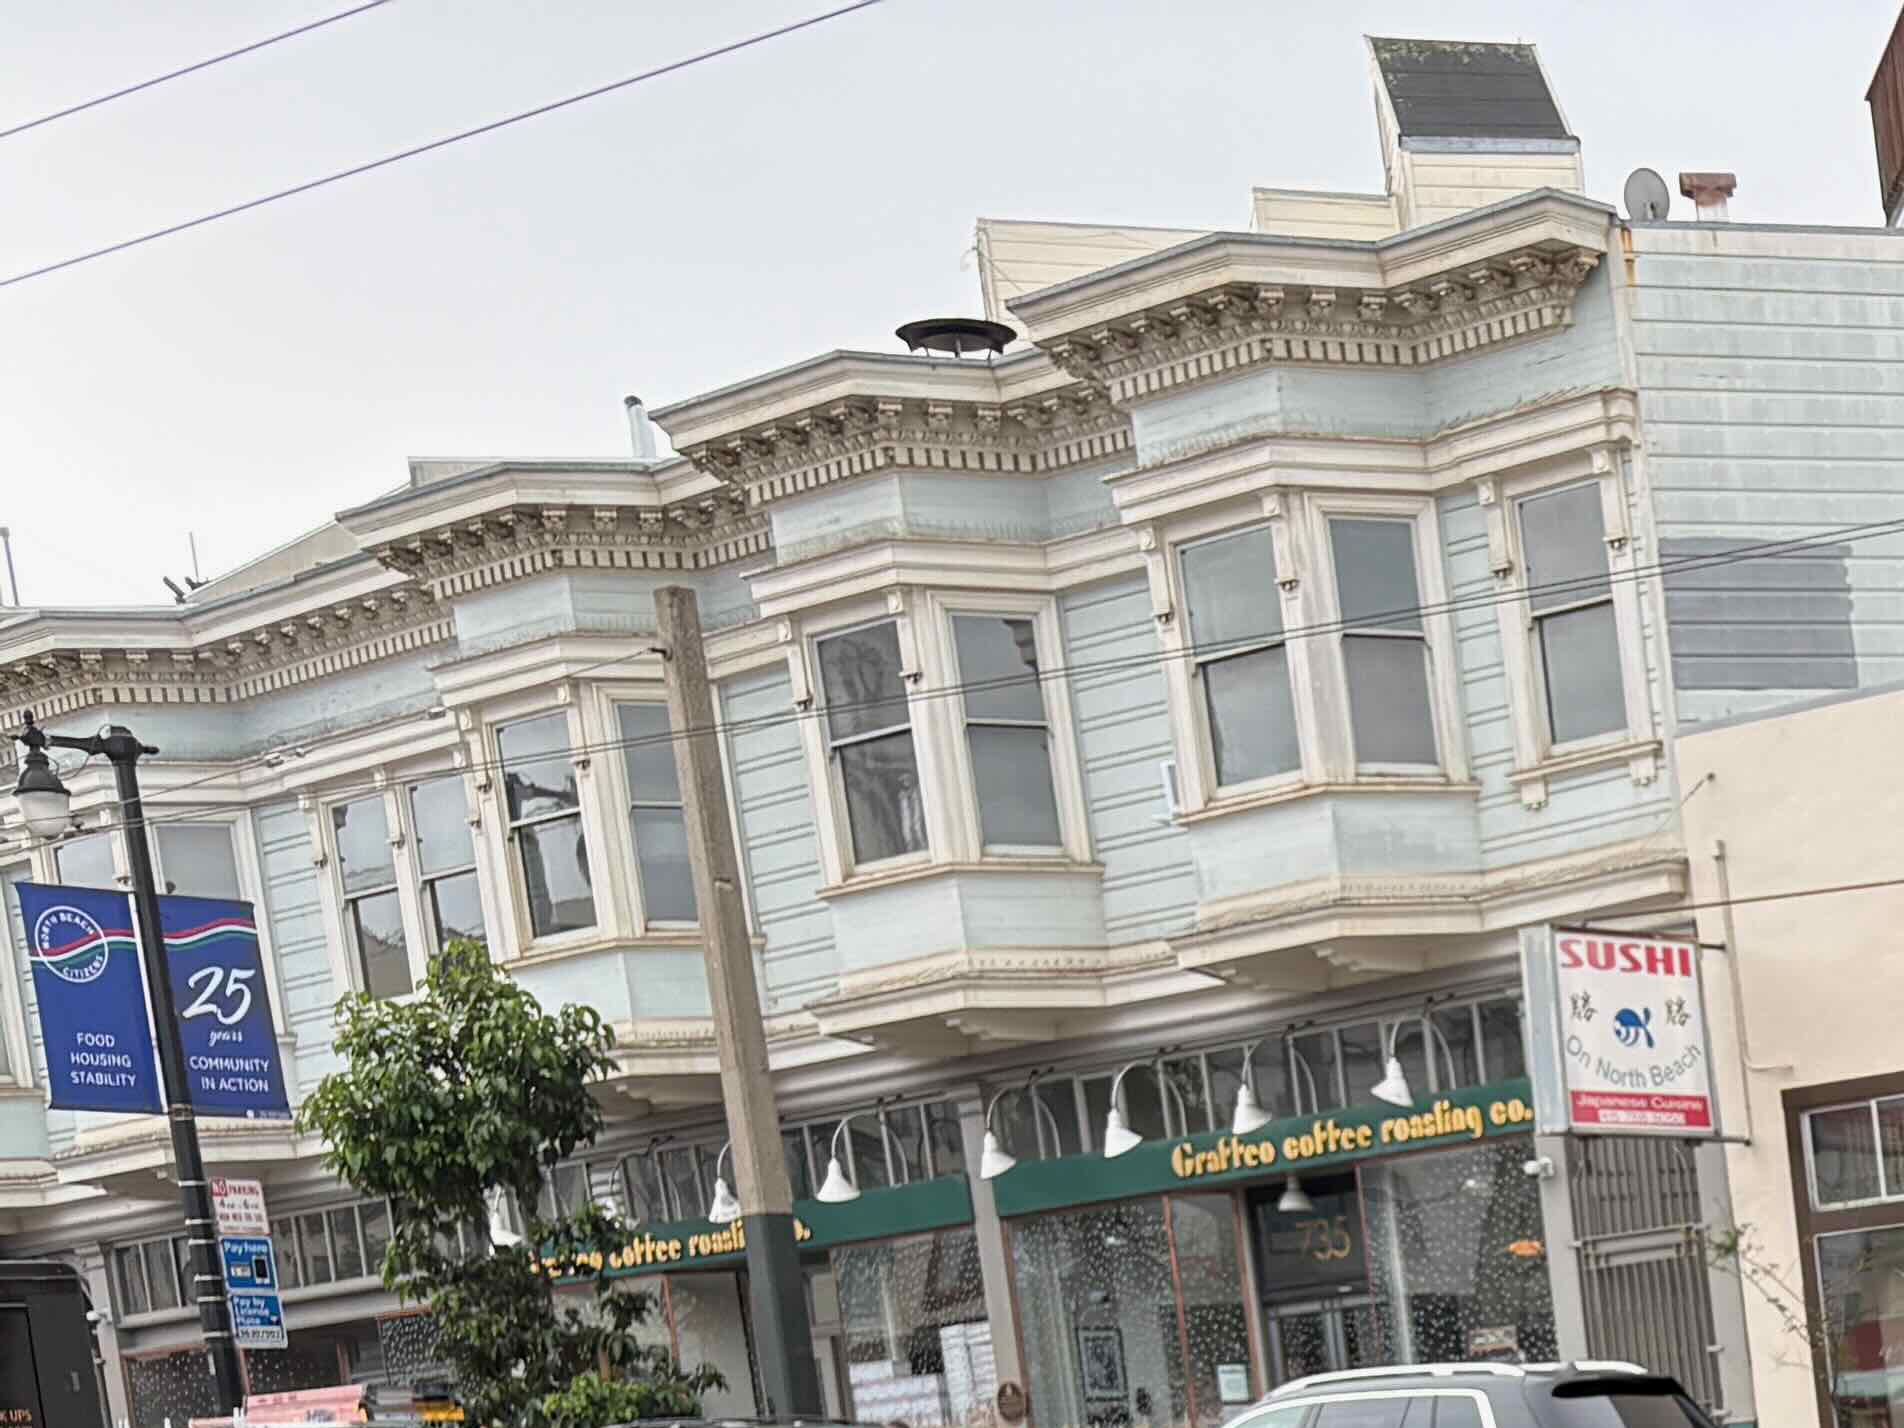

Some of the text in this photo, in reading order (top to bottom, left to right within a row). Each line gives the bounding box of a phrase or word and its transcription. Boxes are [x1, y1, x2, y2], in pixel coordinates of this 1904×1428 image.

[1558, 939, 1692, 977] SUSHI
[182, 966, 256, 1025] 25
[76, 1032, 115, 1048] FOOD
[209, 1030, 243, 1047] years
[70, 1052, 132, 1068] HOUSING
[189, 1055, 270, 1074] COMMUNITY
[1567, 1034, 1702, 1088] On North Beach
[70, 1071, 136, 1087] STABILITY
[201, 1076, 269, 1092] IN ACTION
[1171, 1098, 1534, 1177] Graffeo coffee roasting co.
[211, 1180, 227, 1196] NO
[1296, 1215, 1352, 1262] 735
